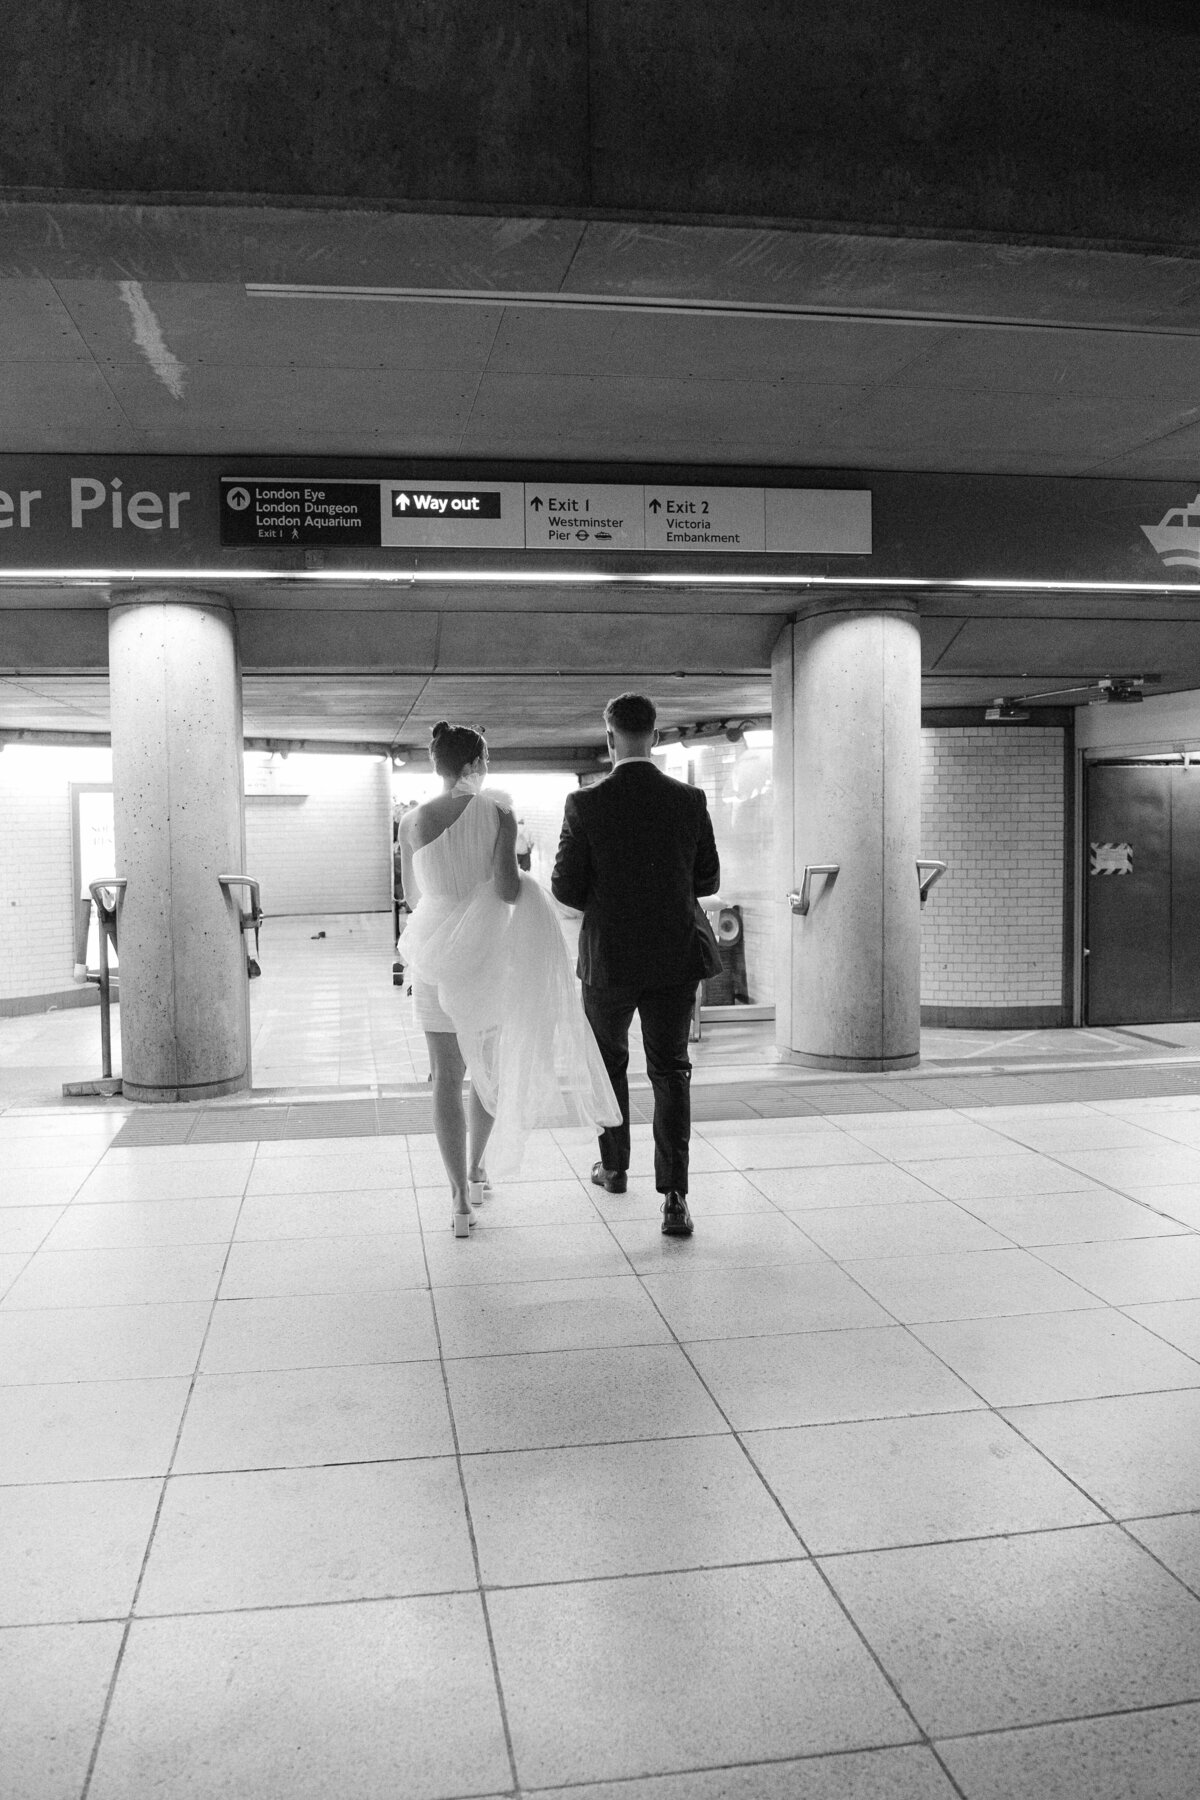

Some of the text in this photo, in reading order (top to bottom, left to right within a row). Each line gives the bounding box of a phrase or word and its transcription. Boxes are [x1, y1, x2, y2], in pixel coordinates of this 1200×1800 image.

[256, 488, 326, 502] London Eye
[70, 477, 191, 529] Pier
[256, 501, 358, 516] London Dungeon
[413, 495, 480, 513] Way out
[548, 498, 579, 512] Exit
[666, 500, 709, 514] Exit 2
[256, 515, 362, 529] London Aquarium
[548, 516, 624, 528] Westminster
[666, 518, 711, 529] Victoria
[258, 529, 277, 538] Exit
[548, 530, 571, 541] Pier
[666, 532, 741, 543] Embankment
